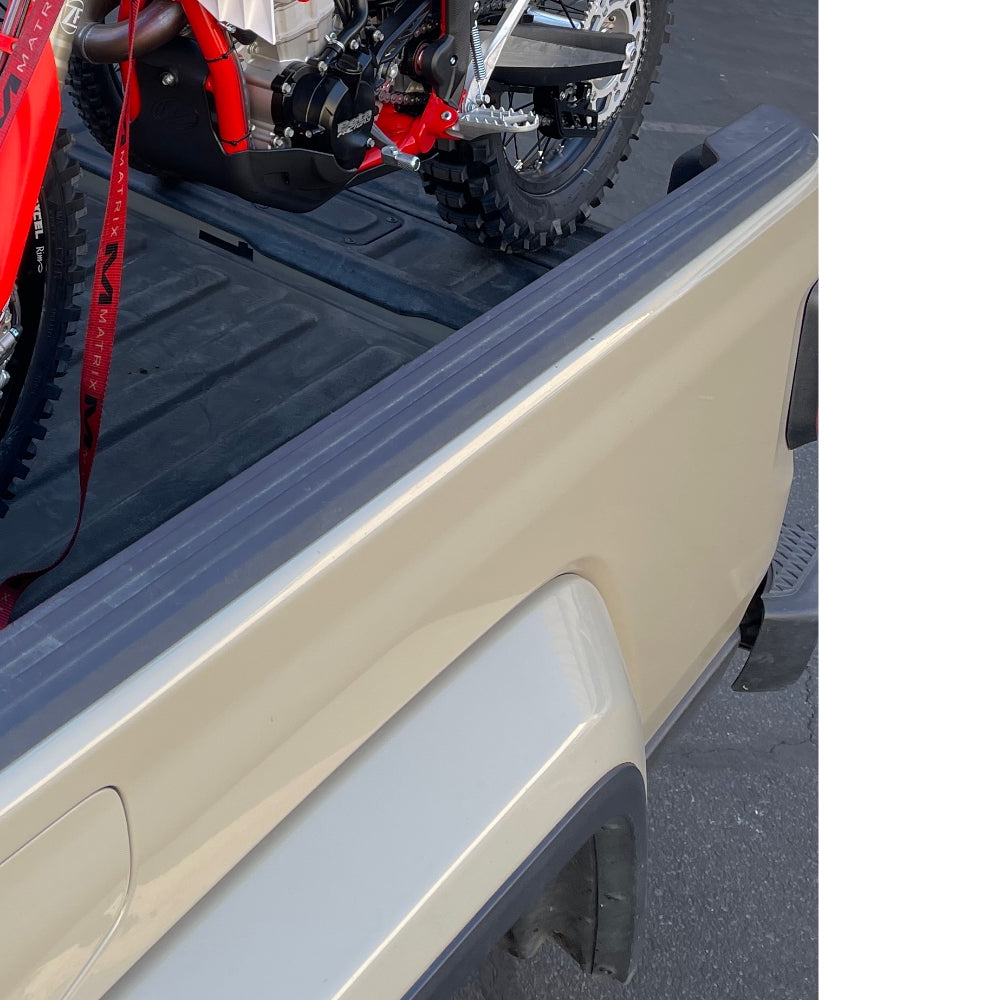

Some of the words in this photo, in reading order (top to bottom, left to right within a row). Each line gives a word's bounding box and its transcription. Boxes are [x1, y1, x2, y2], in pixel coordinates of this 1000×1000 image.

[33, 198, 44, 240] XCEL
[111, 150, 125, 238] MATRIX
[89, 308, 108, 391] MATRIX
